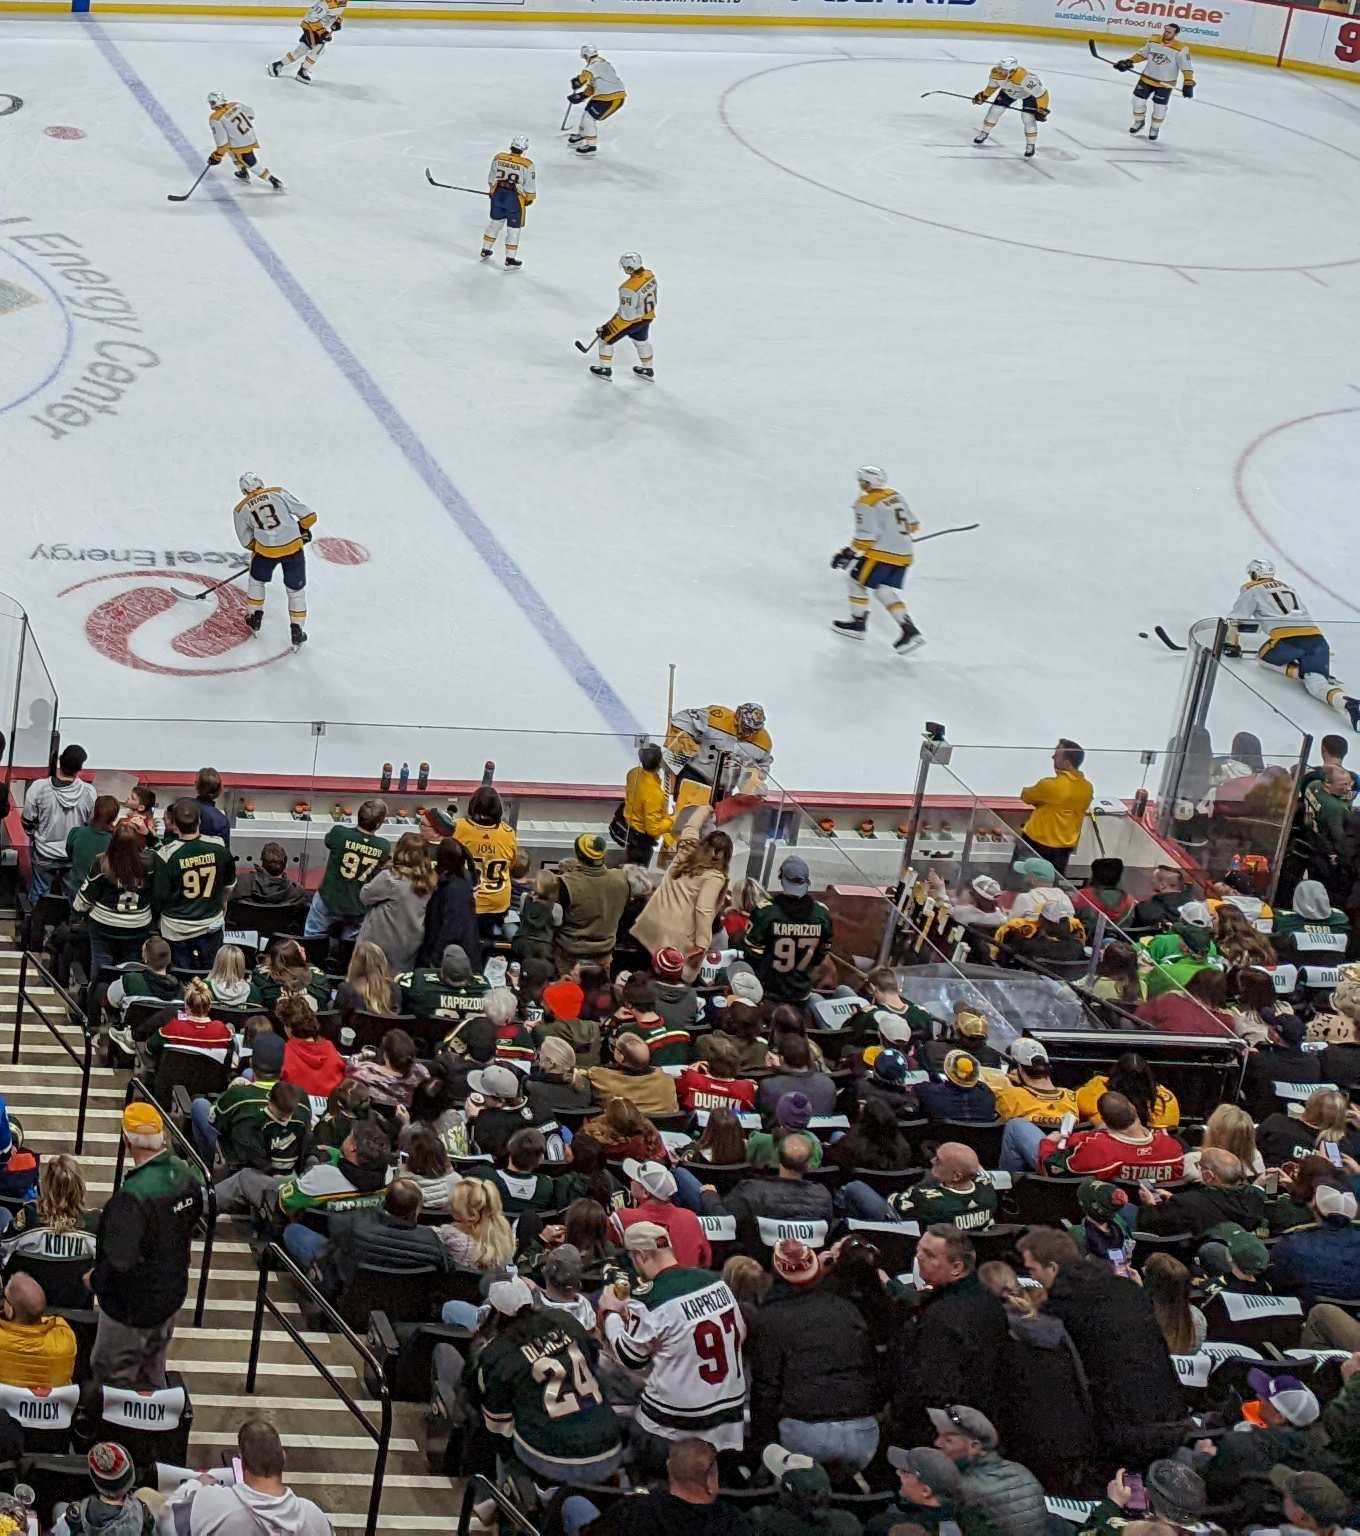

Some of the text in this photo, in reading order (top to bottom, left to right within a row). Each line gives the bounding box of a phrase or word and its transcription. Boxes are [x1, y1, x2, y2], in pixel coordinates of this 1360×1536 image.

[1179, 26, 1220, 37] oodness
[1335, 21, 1360, 63] 9
[9, 232, 143, 334] Energy
[30, 339, 161, 441] Center
[251, 503, 281, 530] 13
[341, 852, 374, 880] 97
[182, 867, 217, 899] 97
[773, 921, 823, 938] KAPRIZOV
[771, 937, 817, 972] 97
[1121, 1162, 1173, 1181] STONER
[44, 1232, 82, 1257] KOIVU
[681, 1282, 731, 1322] KAPRIZOV
[694, 1311, 742, 1385] 97
[531, 1342, 603, 1419] 24
[122, 1399, 166, 1421] KOIVU
